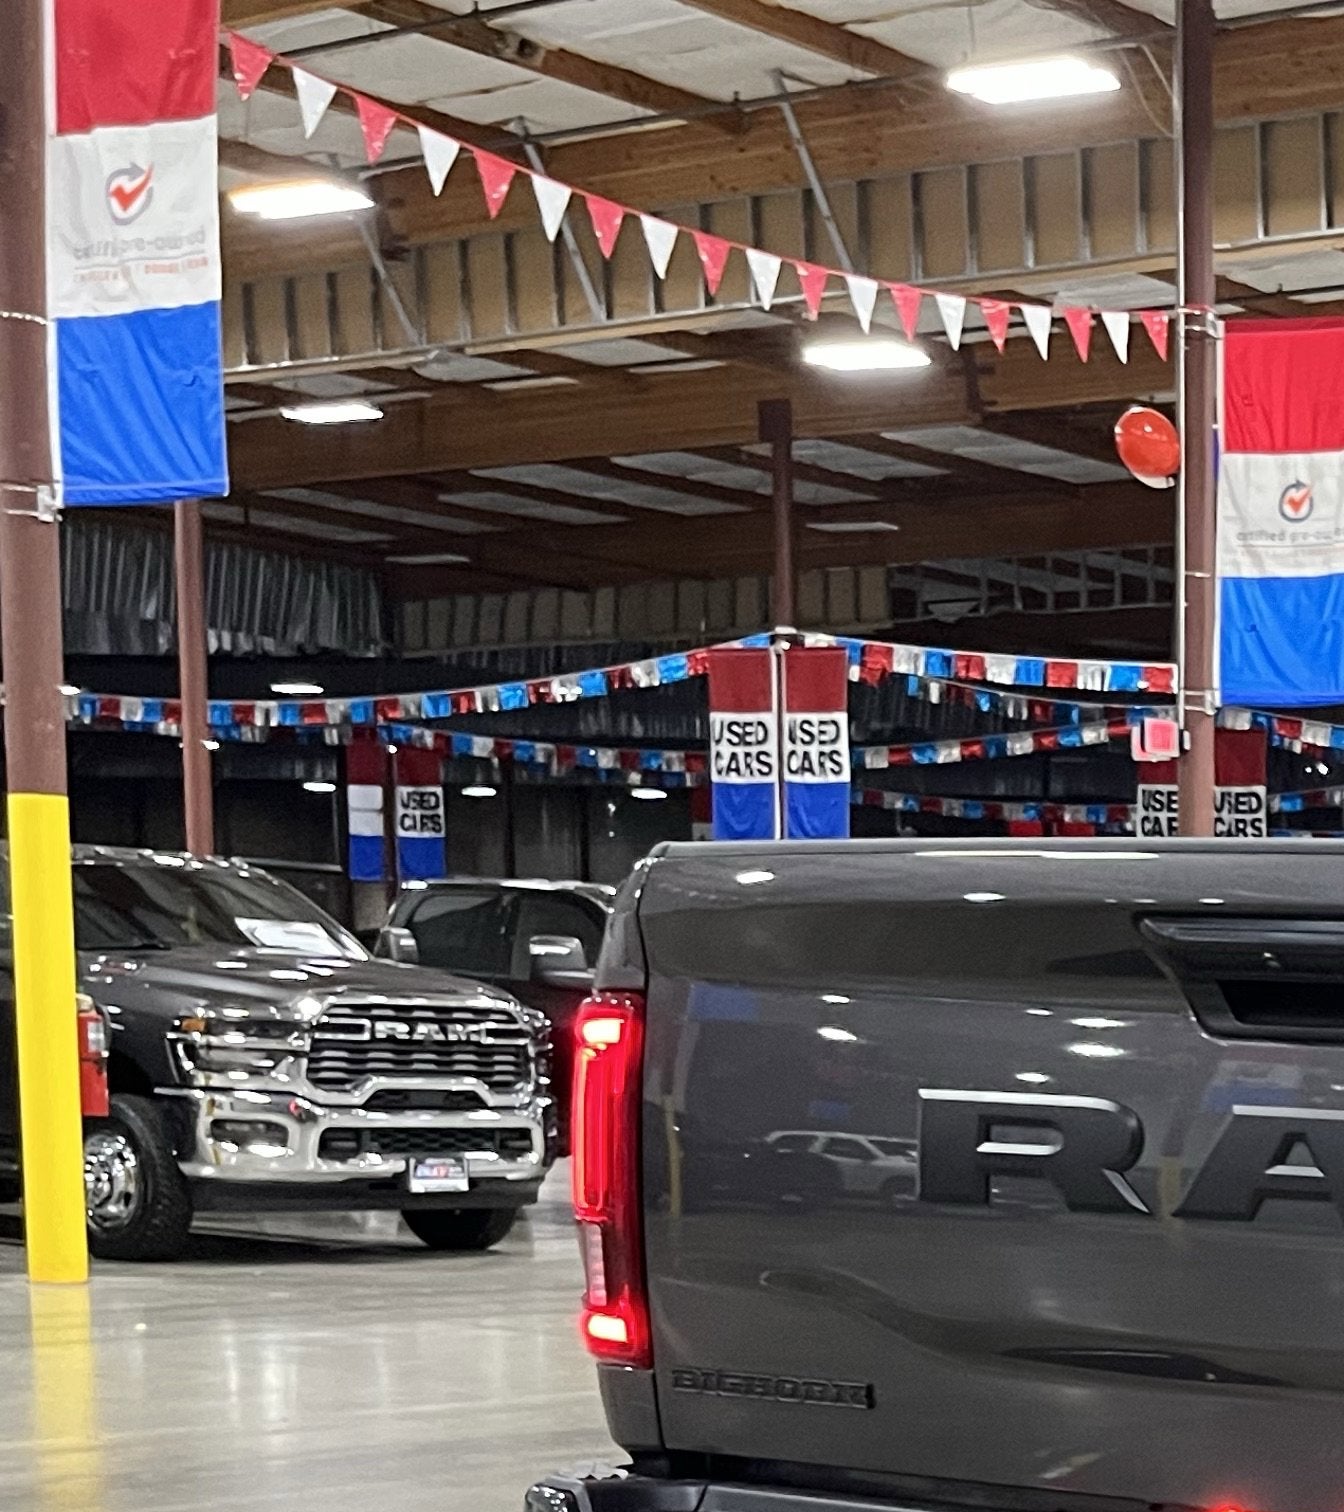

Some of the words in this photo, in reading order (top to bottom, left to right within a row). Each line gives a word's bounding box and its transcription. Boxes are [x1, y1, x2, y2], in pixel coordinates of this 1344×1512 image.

[712, 720, 768, 746] USED
[788, 719, 840, 745] USED
[715, 750, 773, 776] CARS
[787, 750, 843, 776] CARS
[1142, 790, 1179, 812] USE
[375, 1021, 482, 1041] RAM
